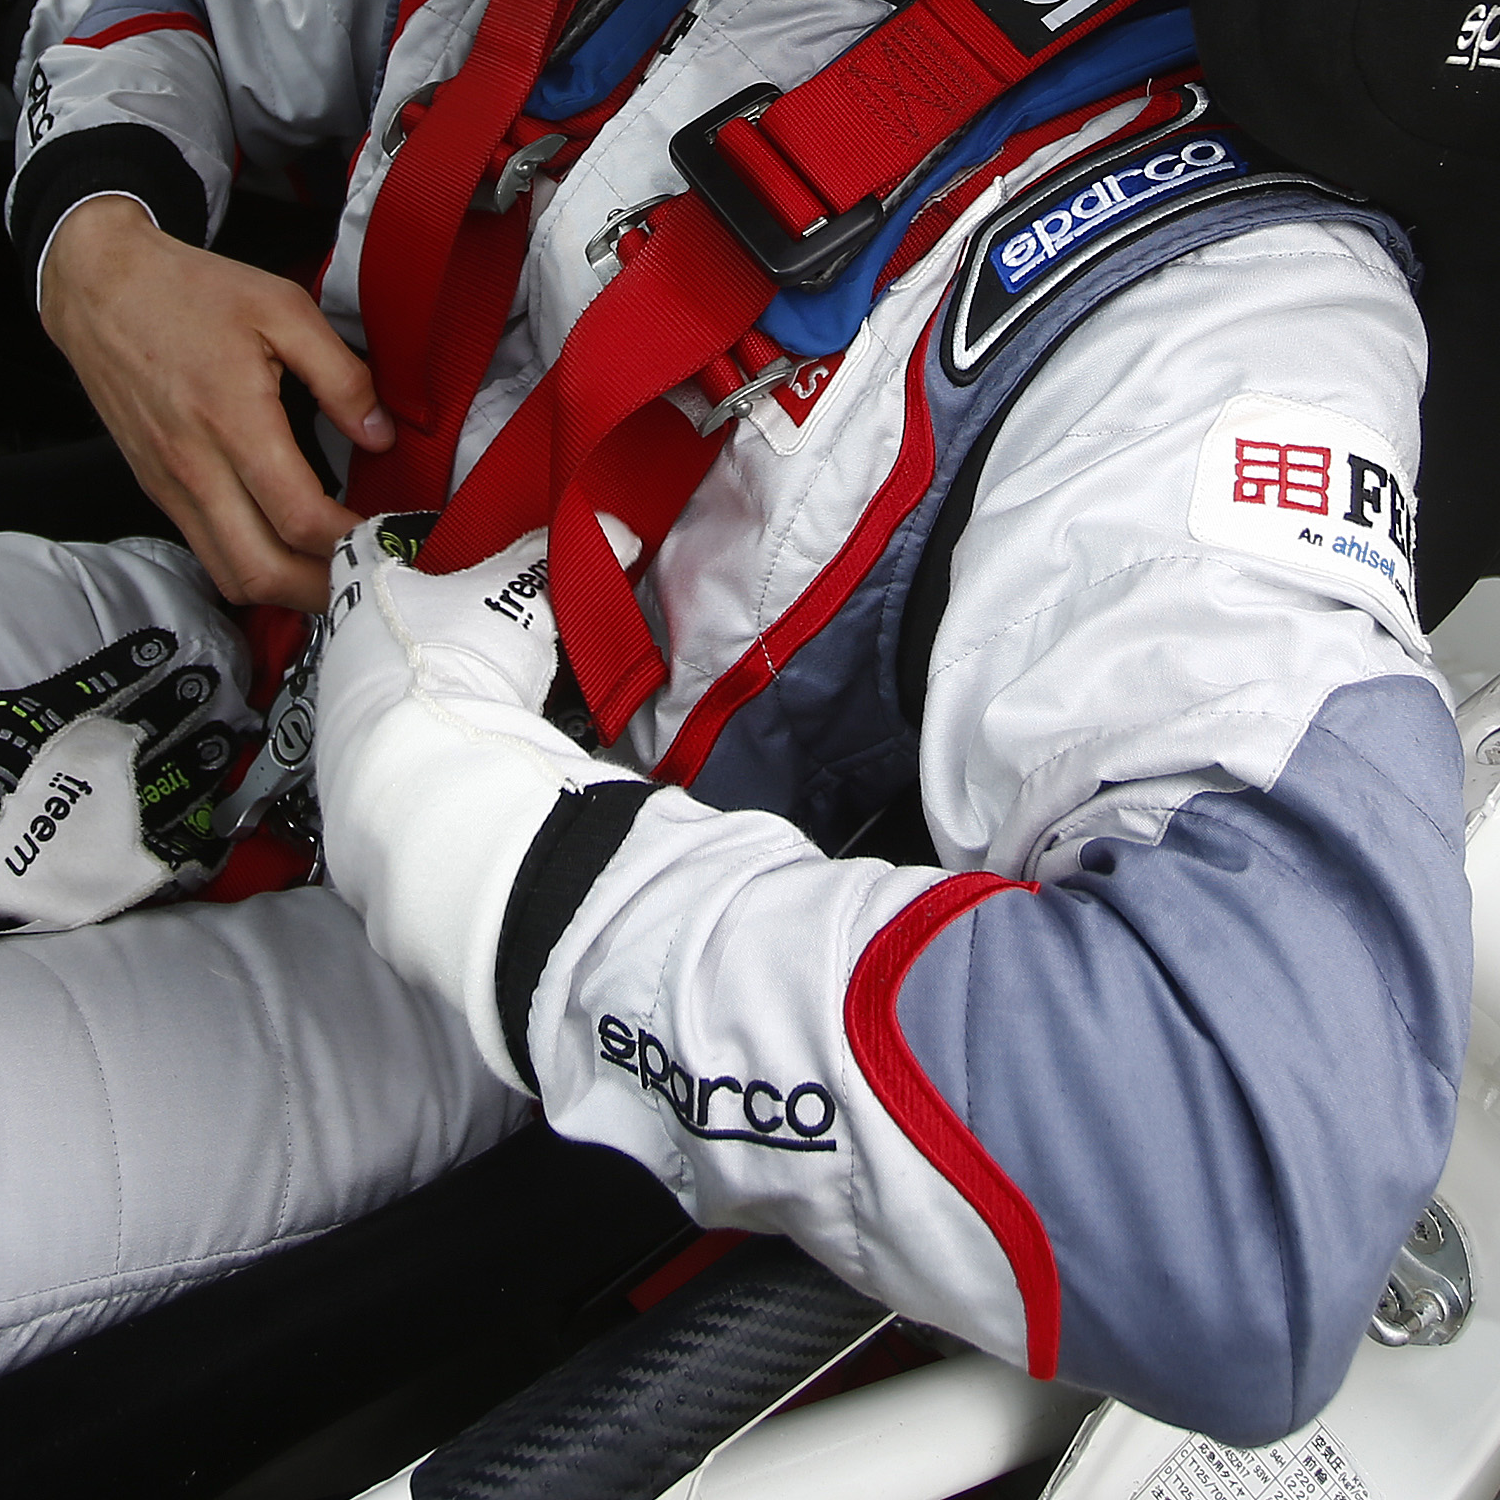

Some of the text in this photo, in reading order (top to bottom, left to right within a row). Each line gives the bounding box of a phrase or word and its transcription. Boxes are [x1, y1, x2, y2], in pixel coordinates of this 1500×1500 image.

[1000, 139, 1236, 284] sparco
[1298, 527, 1324, 547] An
[4, 772, 94, 877] freem
[598, 1013, 838, 1152] sparco
[1253, 1464, 1272, 1485] 93W
[1294, 1469, 1316, 1494] 220
